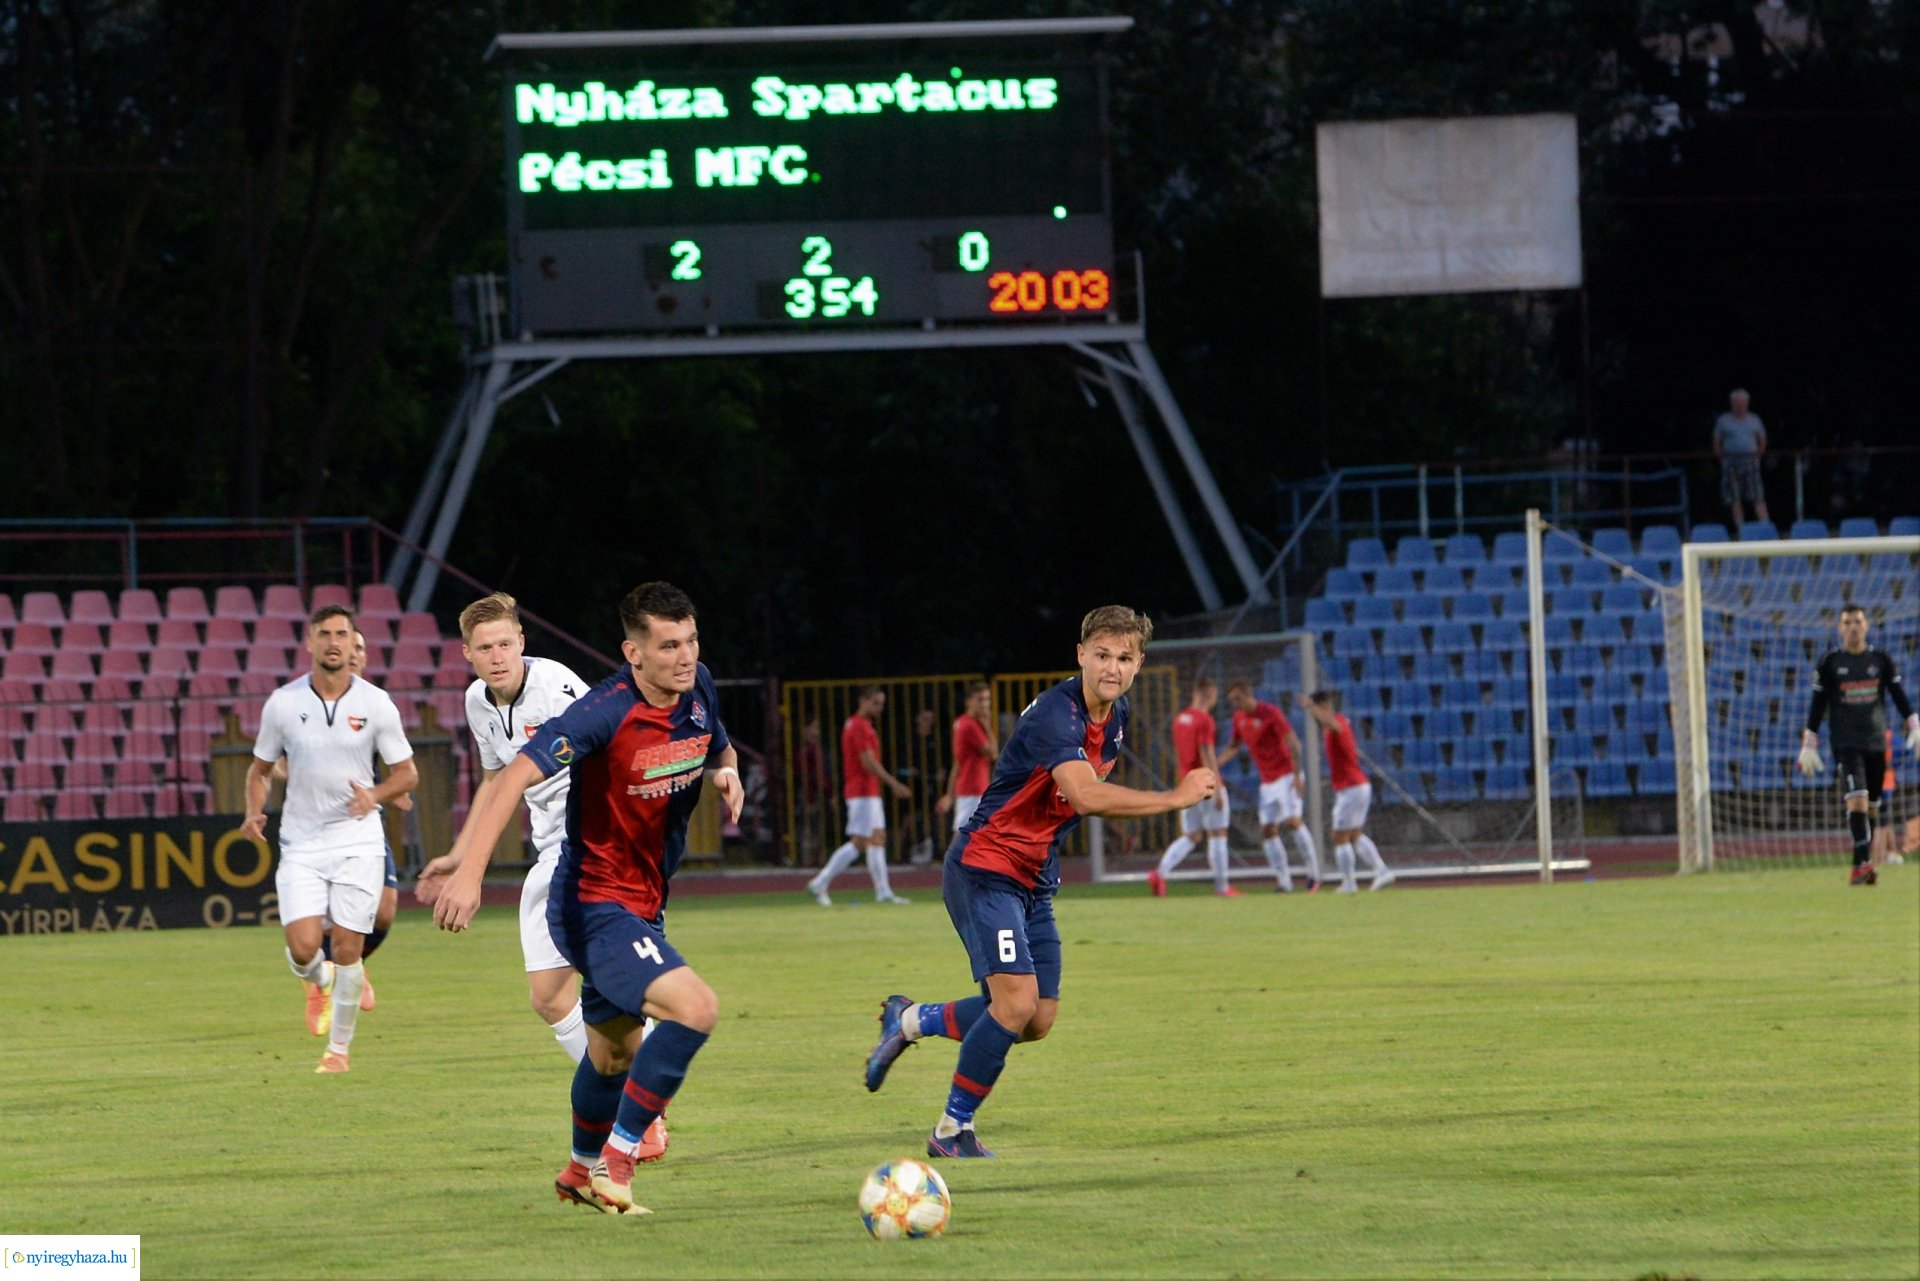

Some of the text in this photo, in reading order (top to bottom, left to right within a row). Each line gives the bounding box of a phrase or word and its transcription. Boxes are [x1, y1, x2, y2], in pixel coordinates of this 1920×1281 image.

[515, 73, 1058, 127] Nyháza Spartacus
[518, 145, 808, 192] Pécsi MFC
[670, 240, 701, 280] 2
[802, 236, 833, 276] 2
[959, 231, 989, 272] 0
[0, 828, 272, 894] ASINO
[632, 936, 664, 965] 4
[997, 929, 1016, 963] 6
